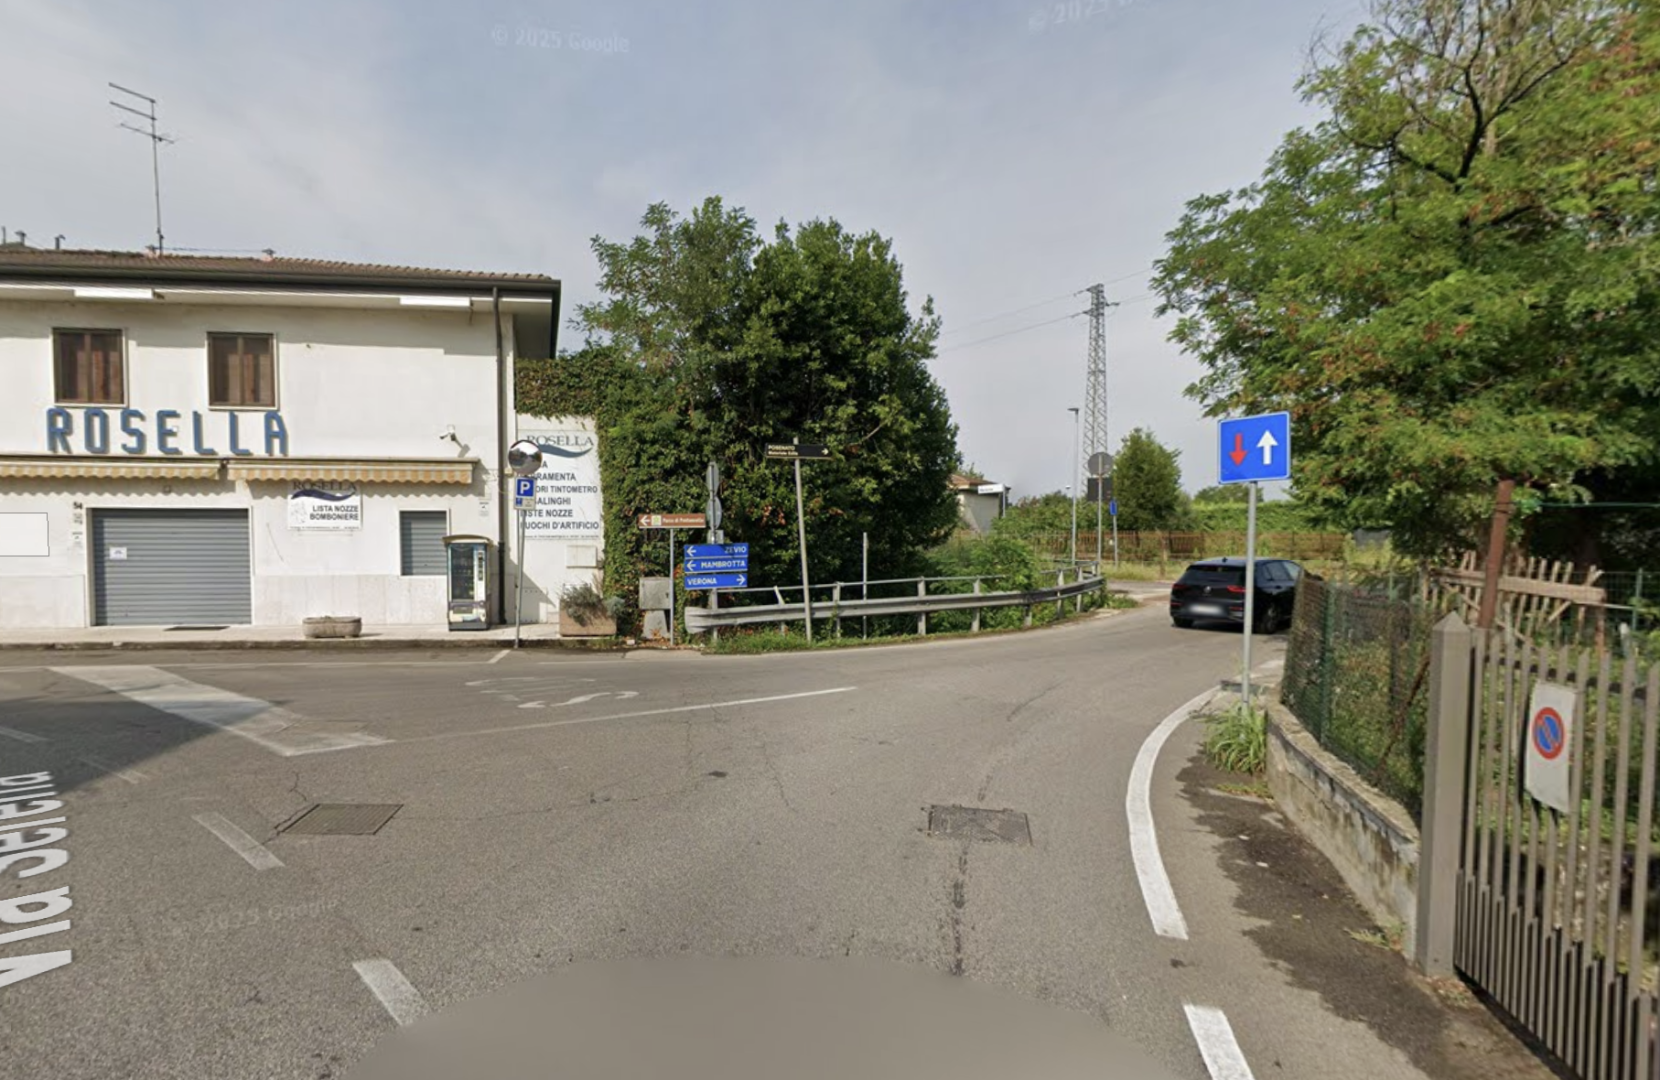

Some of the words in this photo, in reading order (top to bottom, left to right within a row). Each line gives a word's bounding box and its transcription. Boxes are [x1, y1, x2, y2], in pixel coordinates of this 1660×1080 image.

[47, 407, 288, 457] ROSELLA
[527, 435, 594, 446] ROSELLA
[536, 472, 577, 481] RAMENTA
[293, 480, 357, 490] ROSELLA
[520, 481, 531, 494] P
[550, 485, 599, 494] TINTOMETRO
[538, 497, 572, 505] ALINGHI
[309, 513, 359, 521] BOMBONIERE
[545, 509, 574, 517] NOZZE
[551, 521, 600, 530] D'ARTIFICIO
[724, 545, 747, 554] ZEVIO
[700, 560, 746, 569] MAMBROTTA
[686, 577, 718, 586] VERONA
